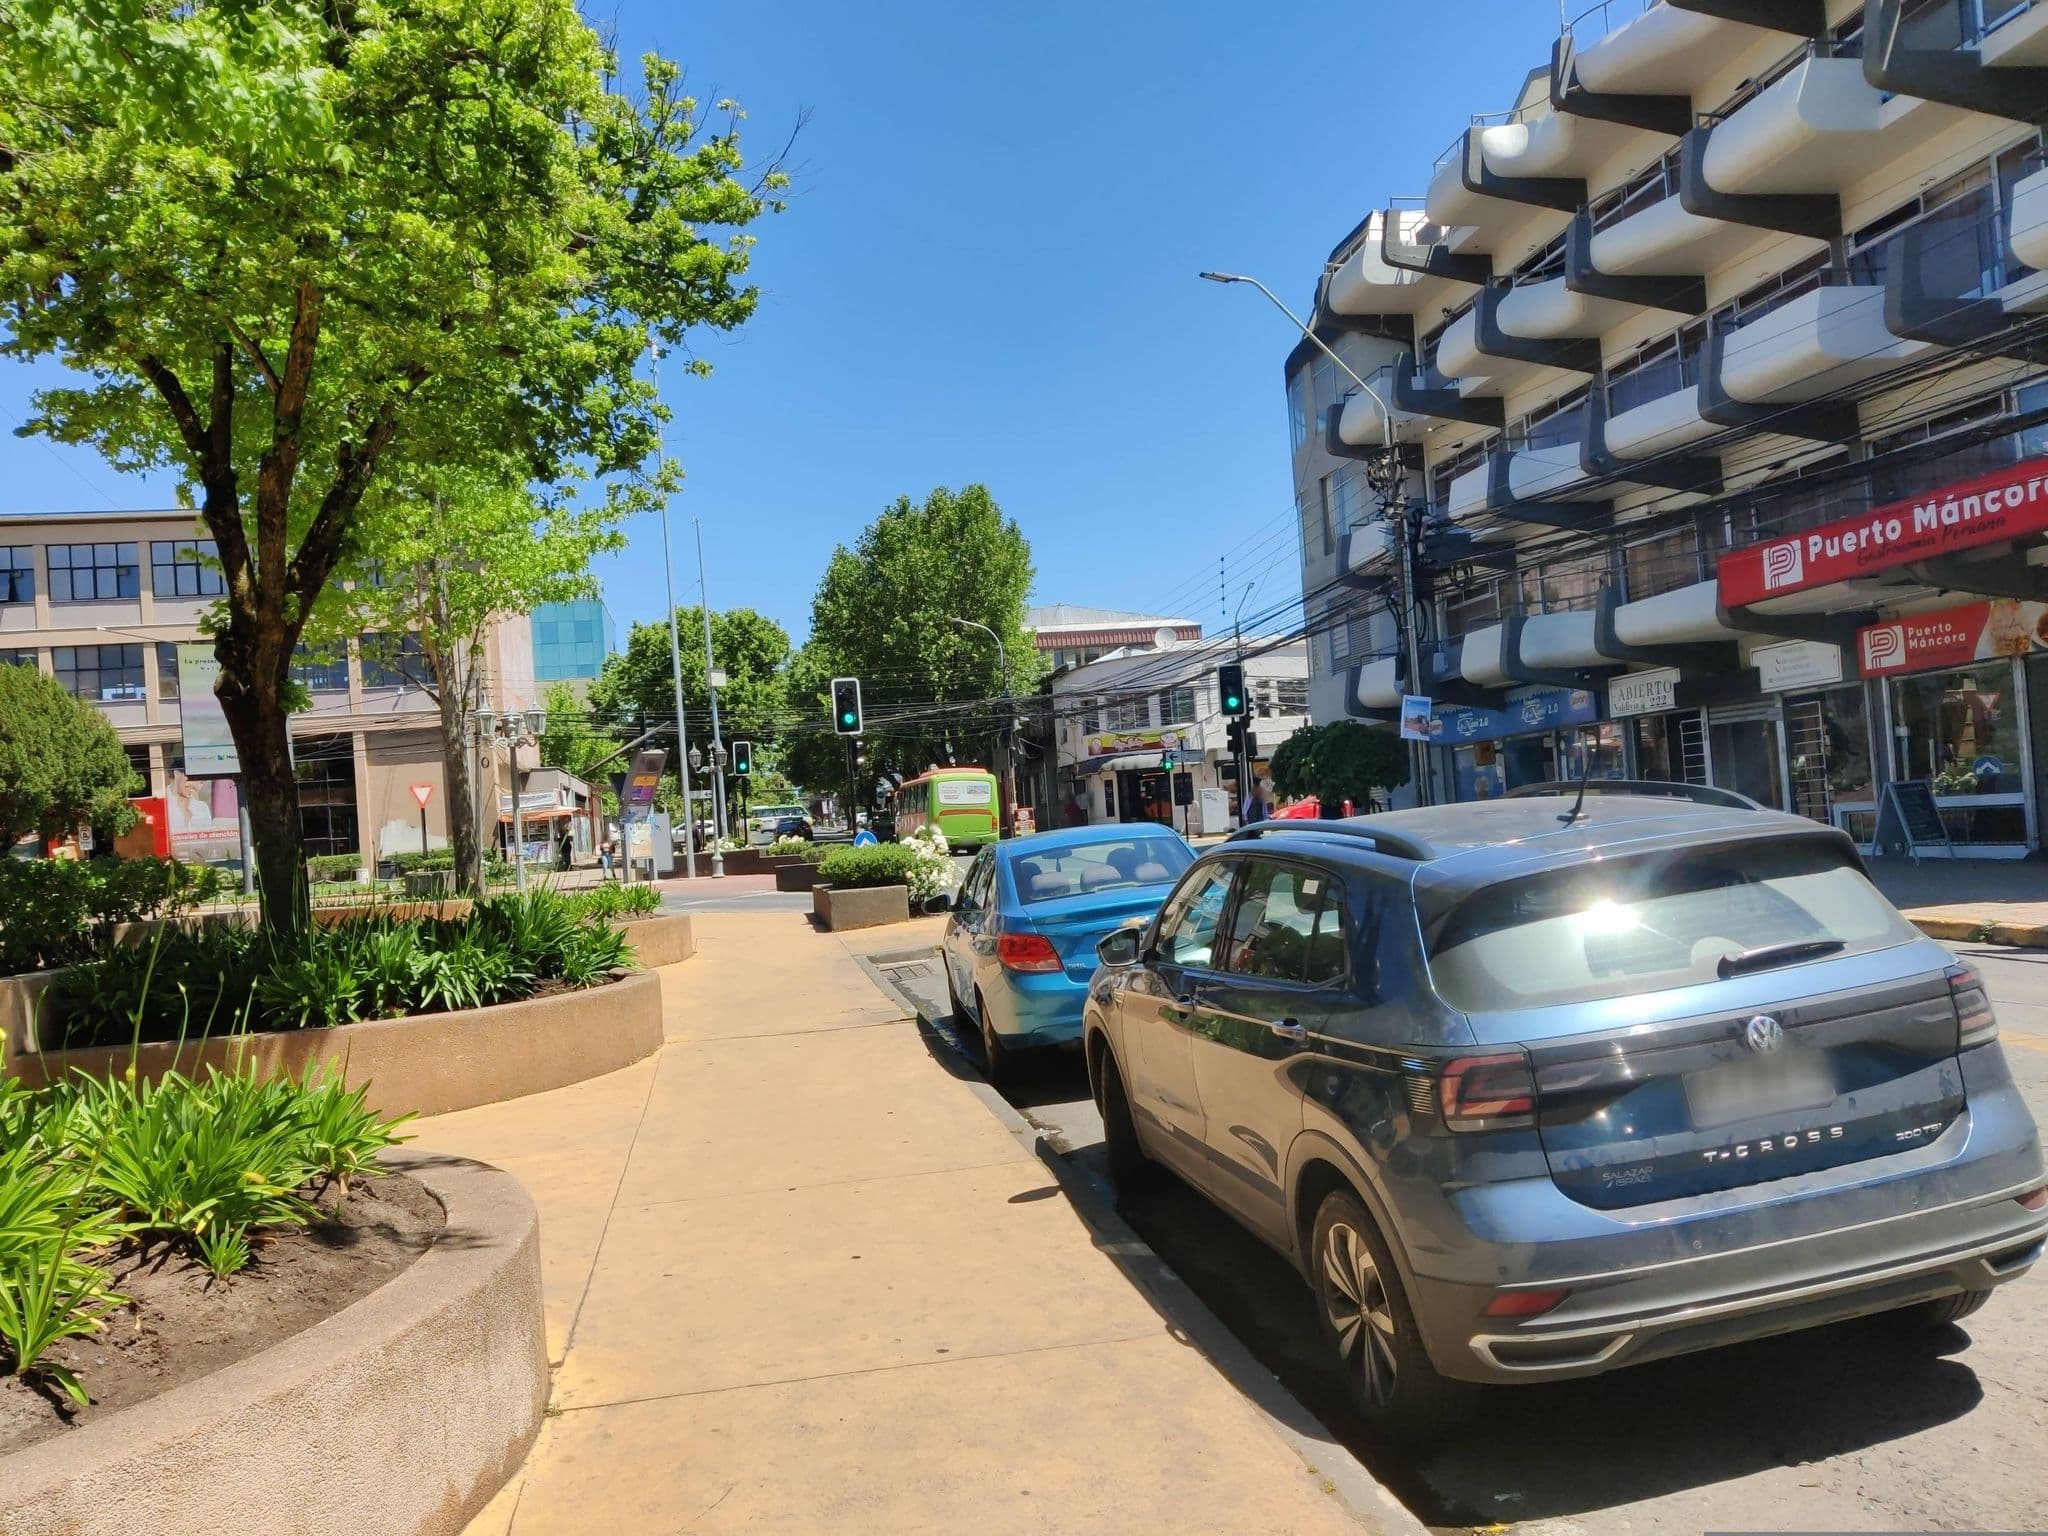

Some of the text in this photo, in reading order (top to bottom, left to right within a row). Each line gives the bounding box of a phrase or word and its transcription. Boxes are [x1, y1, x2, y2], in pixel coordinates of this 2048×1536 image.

[1808, 518, 1902, 562] Puerto
[1908, 623, 1952, 638] Puerto
[1908, 633, 1966, 649] Máncora
[1618, 681, 1672, 701] ABIERTO
[1548, 702, 1558, 714] 2.0
[1650, 695, 1667, 707] 222
[1479, 716, 1489, 727] 2.0
[1703, 1126, 1843, 1163] T-CROSS
[1602, 1166, 1653, 1181] SALAZAR
